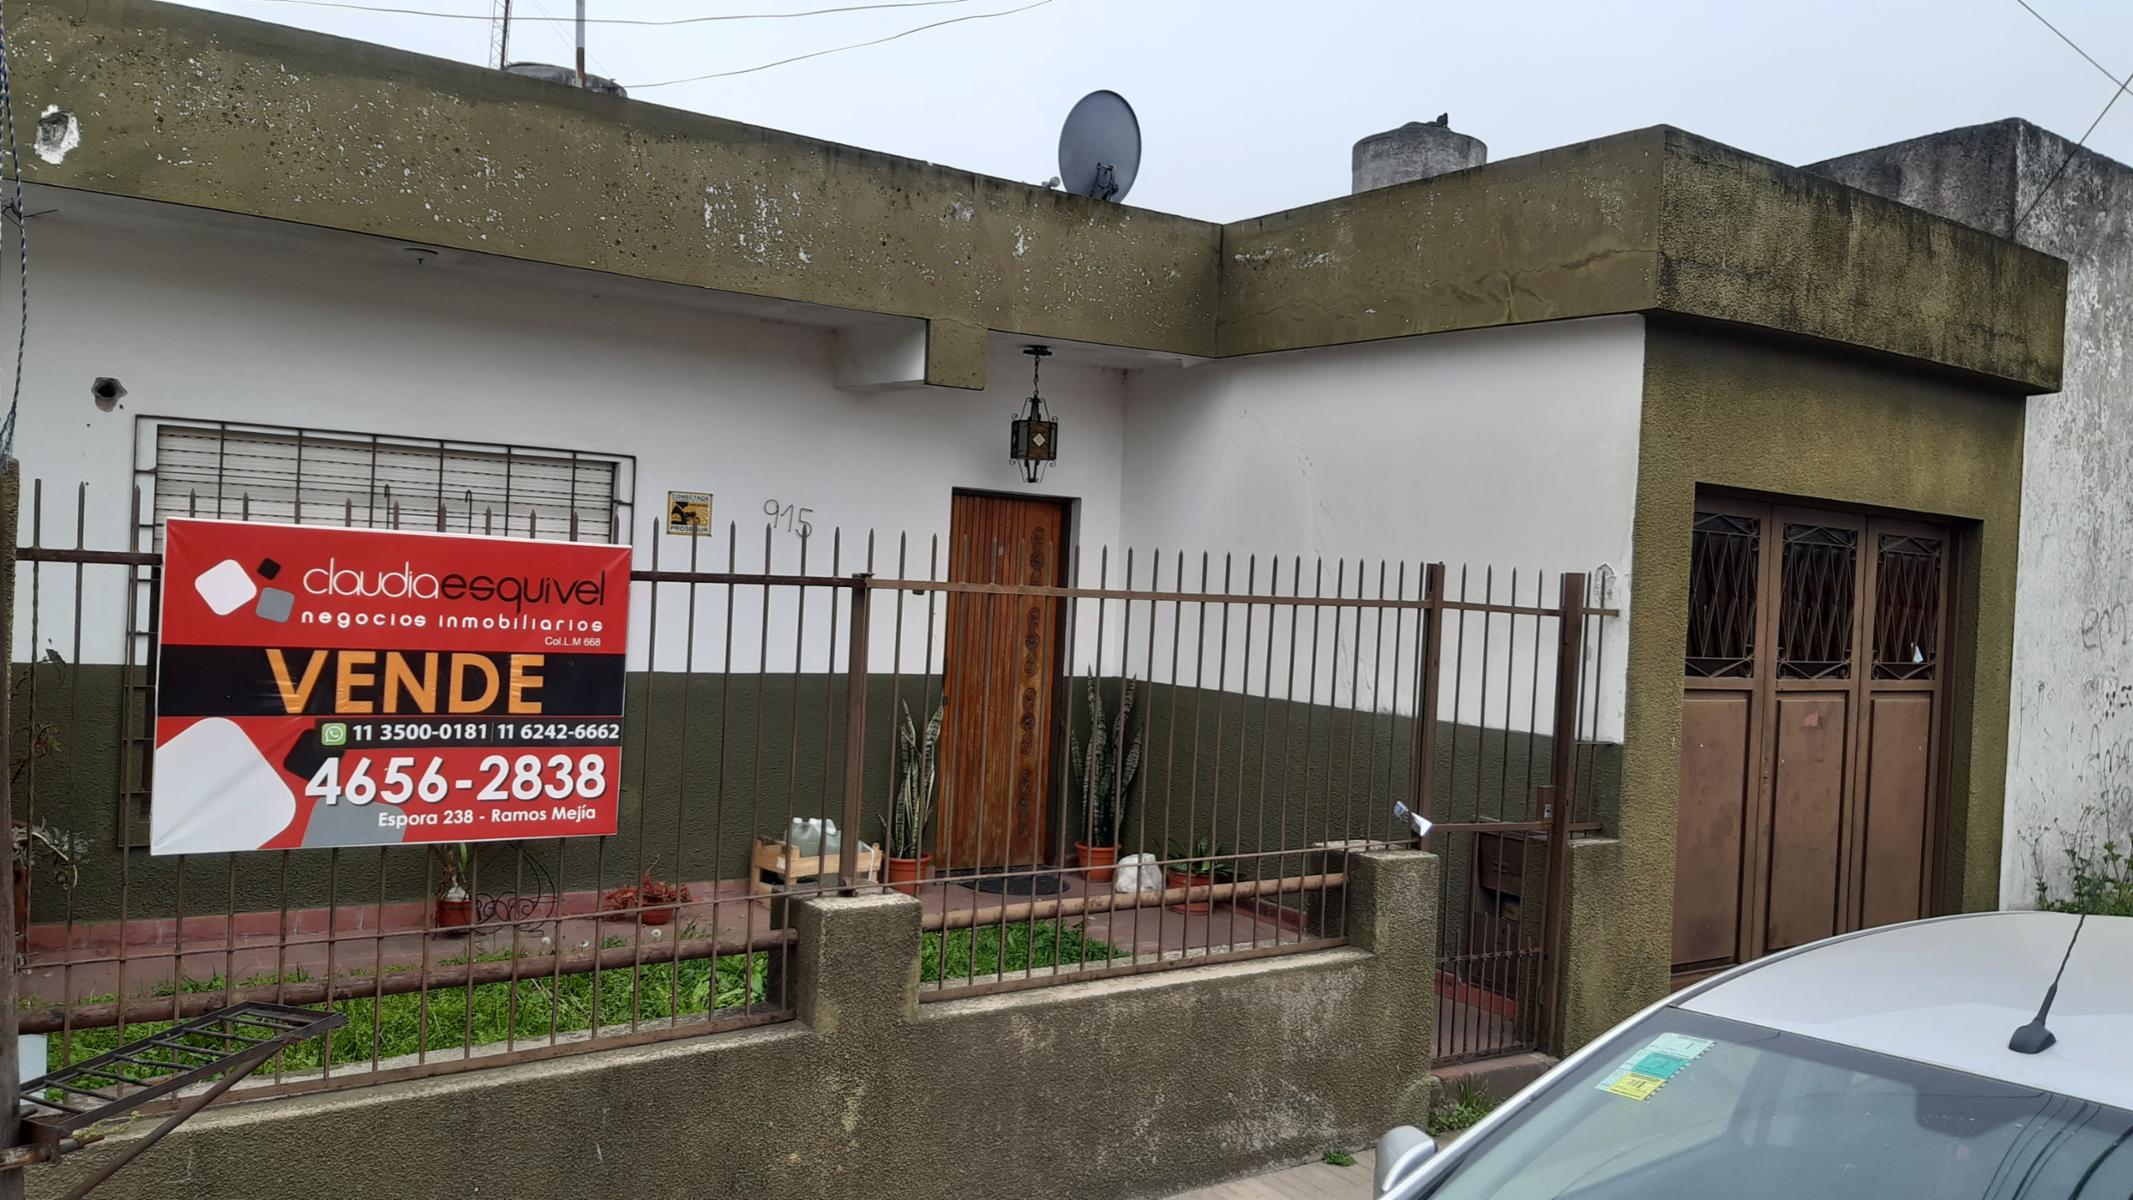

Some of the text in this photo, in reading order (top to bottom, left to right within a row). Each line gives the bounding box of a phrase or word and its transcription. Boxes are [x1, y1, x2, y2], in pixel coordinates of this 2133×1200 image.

[764, 499, 814, 538] 915
[301, 610, 604, 632] negocios inmobiliarios
[583, 637, 602, 648] 668
[265, 648, 546, 714] VENDE
[352, 723, 620, 741] 11 3500-0181 11 6242-6662
[304, 753, 607, 806] 4656-2838
[378, 811, 438, 828] Espora
[443, 809, 474, 824] 238
[491, 808, 547, 823] Ramos
[551, 804, 597, 823] Mejía
